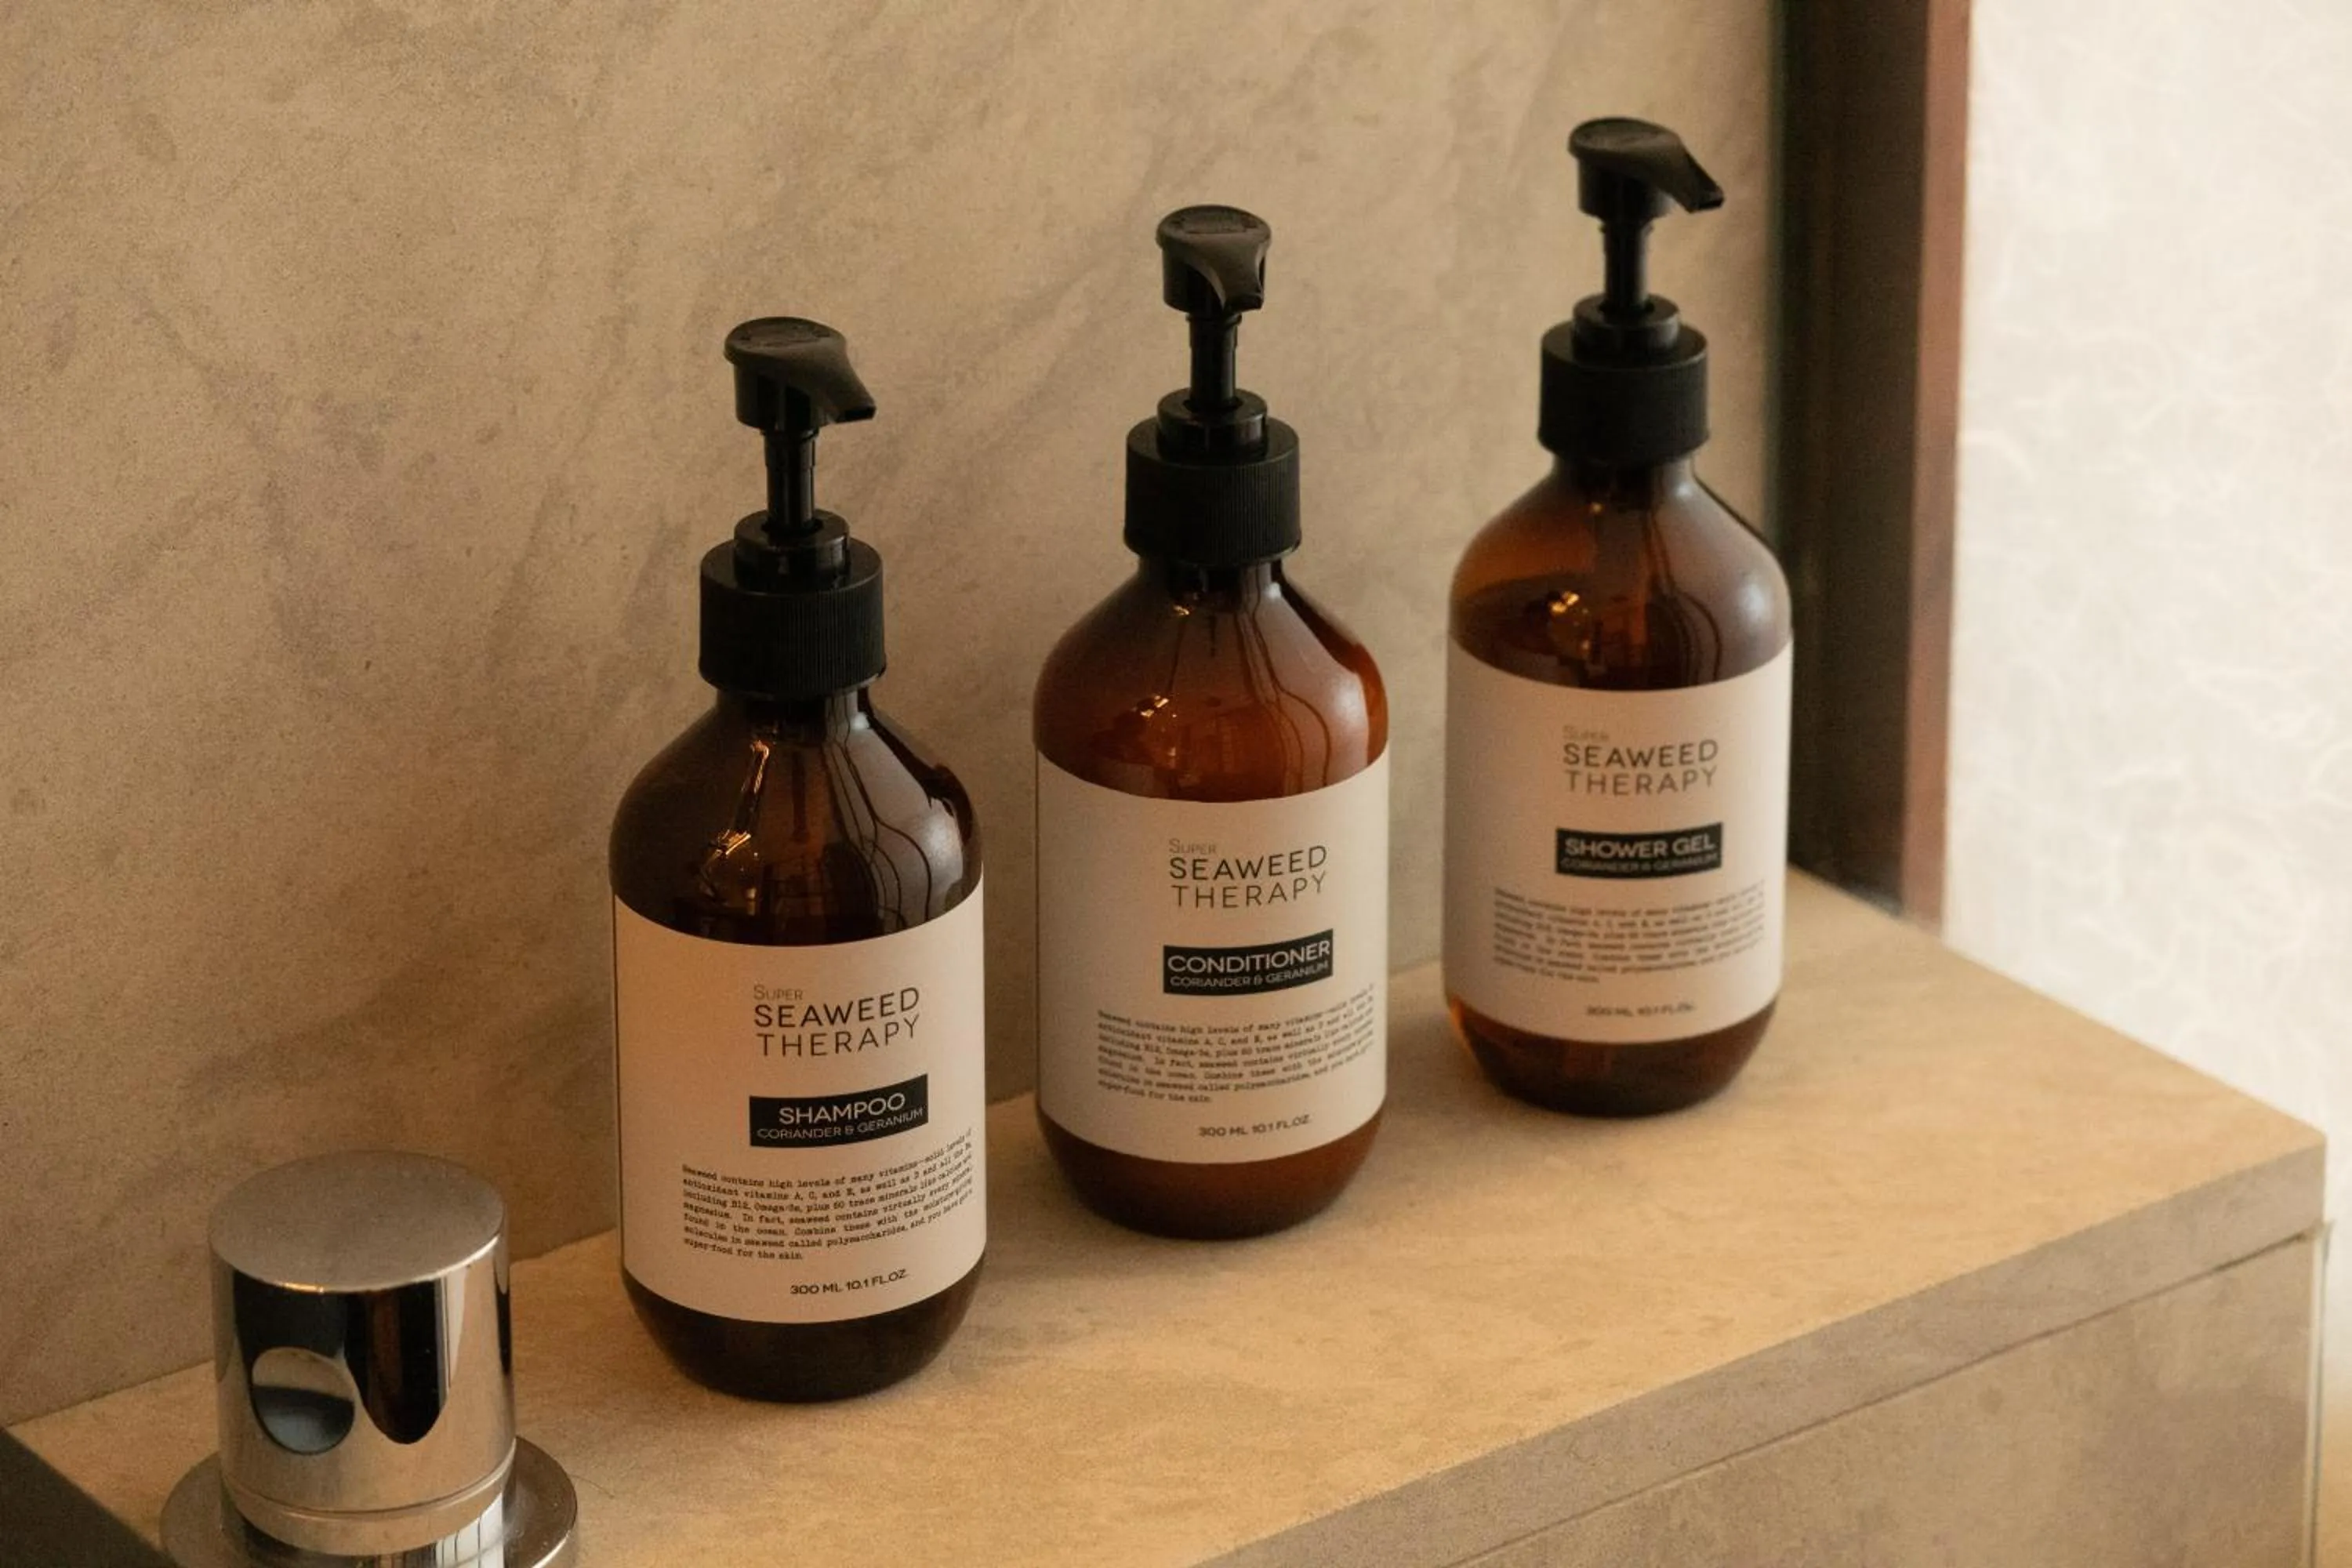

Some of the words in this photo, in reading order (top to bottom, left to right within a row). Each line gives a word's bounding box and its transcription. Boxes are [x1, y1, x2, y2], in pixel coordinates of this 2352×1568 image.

[1563, 739, 1719, 768] SEAWEED
[1565, 764, 1717, 796] THERAPY
[1565, 837, 1668, 858] SHOWER
[1672, 833, 1715, 855] GEL
[1170, 845, 1327, 880] SEAWEED
[1171, 870, 1326, 908] THERAPY
[1167, 940, 1330, 974] CONDITIONER
[1170, 976, 1250, 987] CORIANDER
[1254, 975, 1261, 985] &
[1265, 960, 1328, 984] GERANIUM
[754, 987, 920, 1028] SEAWEED
[757, 1014, 920, 1057] THERAPY
[1180, 1025, 1203, 1034] high
[1207, 1025, 1239, 1034] levels
[779, 1093, 906, 1124] SHAMPOO
[1149, 1091, 1165, 1099] for
[1168, 1093, 1185, 1102] the
[757, 1127, 840, 1139] CORIANDER
[845, 1125, 854, 1135] &
[857, 1107, 924, 1134] GERANIUM
[1199, 1127, 1226, 1137] 300
[682, 1163, 717, 1181] Seaweed
[721, 1175, 764, 1187] contains
[769, 1178, 793, 1189] high
[797, 1179, 830, 1188] levels
[835, 1176, 846, 1185] of
[851, 1174, 874, 1183] many
[683, 1178, 739, 1196] antioxidant
[744, 1191, 789, 1200] vitamins
[794, 1192, 804, 1201] A,
[808, 1192, 818, 1200] C,
[822, 1190, 840, 1199] and
[847, 1188, 855, 1196] E,
[876, 1178, 896, 1191] well
[900, 1176, 910, 1185] as
[923, 1164, 937, 1176] and
[940, 1156, 951, 1168] all
[684, 1189, 728, 1209] including
[807, 1203, 830, 1214] plus
[849, 1196, 876, 1208] trace
[878, 1185, 917, 1202] minerals
[920, 1178, 937, 1189] like
[742, 1214, 753, 1222] In
[759, 1214, 785, 1225] fact,
[789, 1214, 829, 1224] seaweed
[835, 1208, 879, 1221] contains
[883, 1193, 926, 1213] virtually
[930, 1181, 949, 1197] every
[684, 1213, 710, 1227] found
[715, 1221, 727, 1230] in
[733, 1225, 750, 1234] the
[794, 1227, 836, 1236] Combine
[844, 1221, 870, 1232] these
[877, 1215, 898, 1226] with
[904, 1208, 918, 1219] the
[684, 1225, 728, 1243] molecules
[731, 1235, 742, 1244] in
[745, 1238, 785, 1247] seaweed
[789, 1238, 822, 1248] called
[910, 1216, 926, 1229] and
[927, 1210, 942, 1224] you
[737, 1248, 753, 1258] for
[757, 1250, 775, 1260] the
[790, 1285, 819, 1294] 300
[846, 1278, 869, 1291] 10.1
